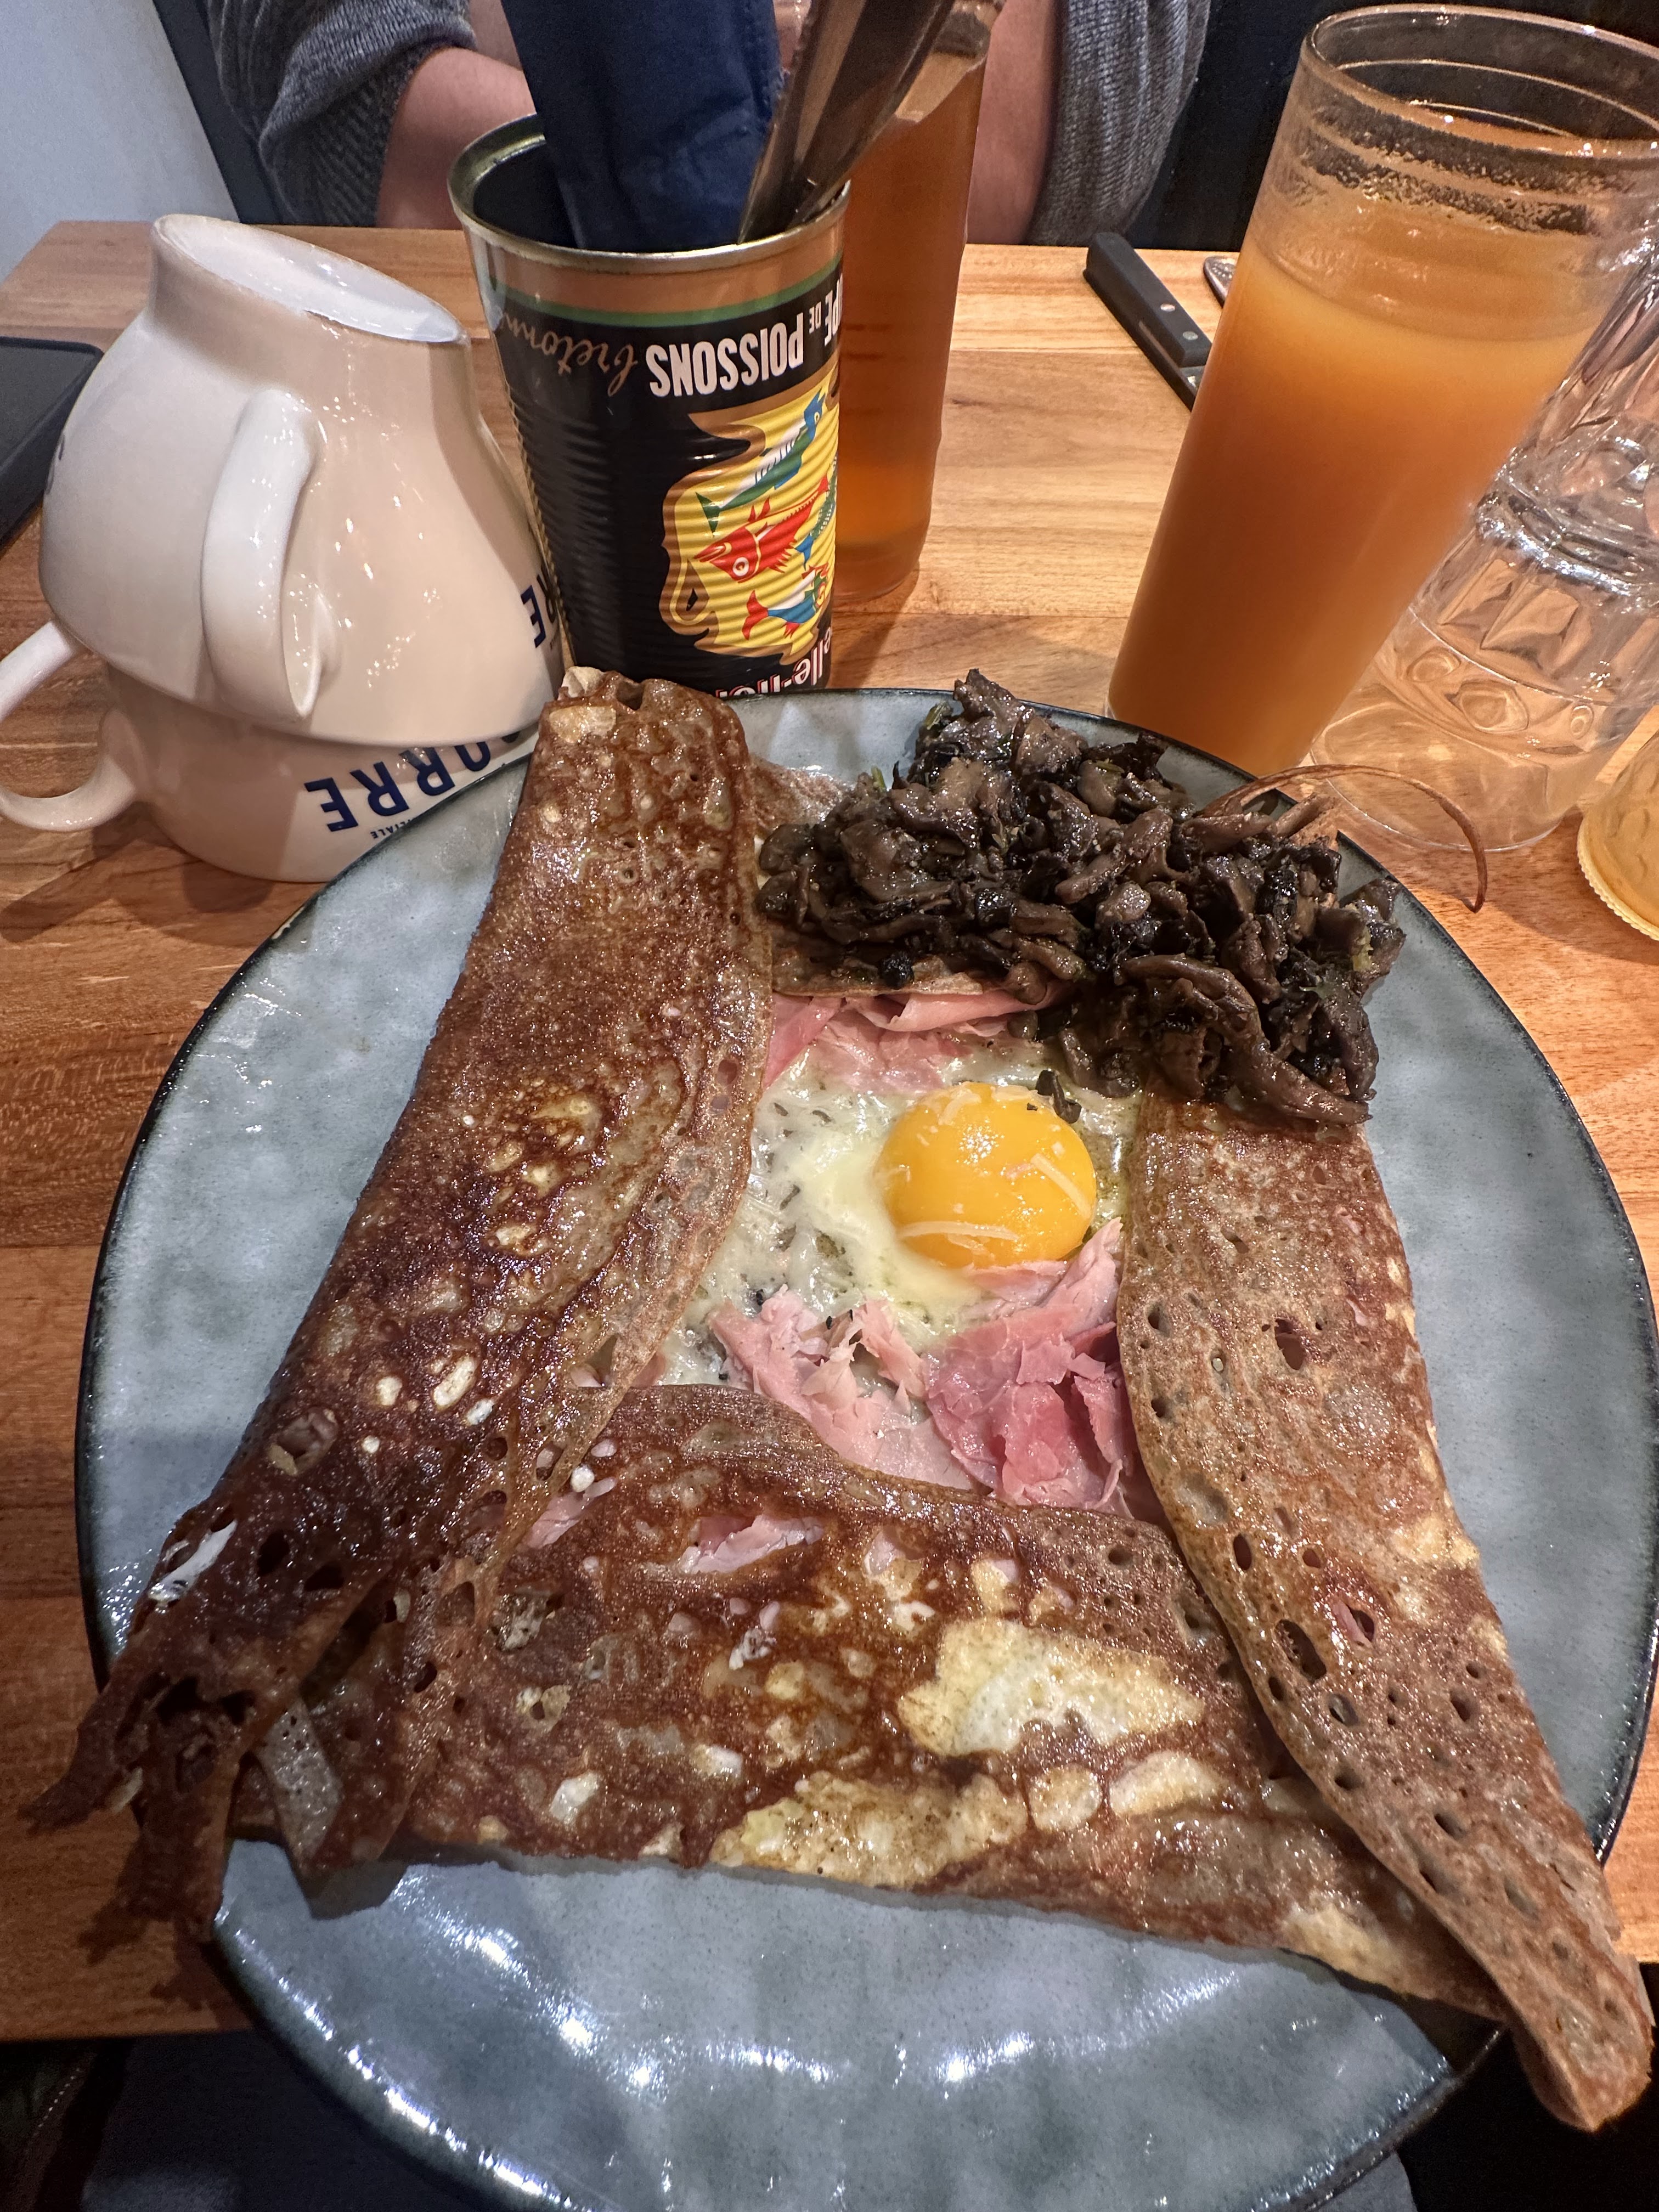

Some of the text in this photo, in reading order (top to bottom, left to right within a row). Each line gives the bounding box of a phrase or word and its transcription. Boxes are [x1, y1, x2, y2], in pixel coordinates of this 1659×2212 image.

[646, 312, 804, 398] POISSONS
[809, 301, 822, 334] DE
[303, 731, 520, 832] ORRE
